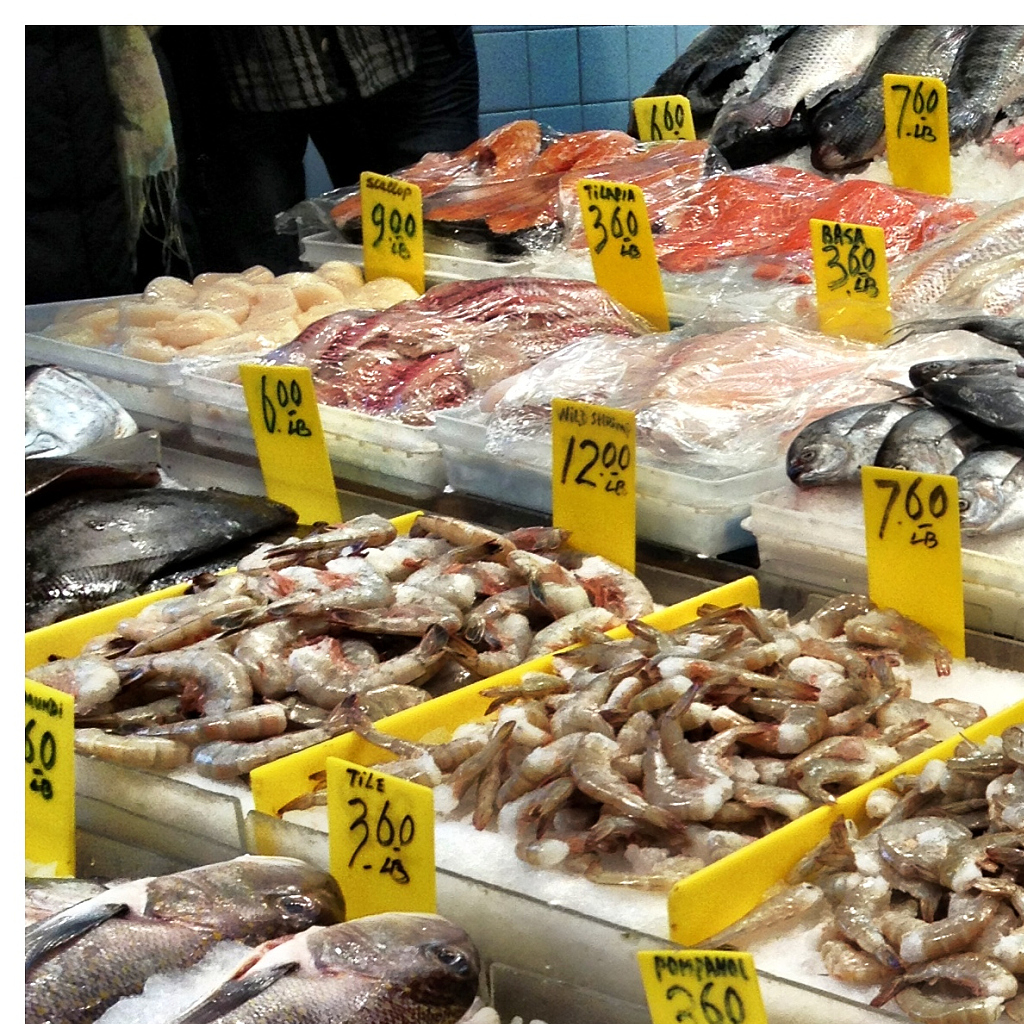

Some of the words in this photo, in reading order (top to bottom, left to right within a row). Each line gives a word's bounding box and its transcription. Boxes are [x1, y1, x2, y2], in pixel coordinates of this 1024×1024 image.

[914, 124, 937, 142] LB
[821, 223, 865, 246] BASA
[620, 244, 641, 259] LB
[288, 418, 311, 437] LB
[910, 532, 938, 549] LB
[346, 768, 385, 792] TiLE
[380, 858, 410, 885] LB
